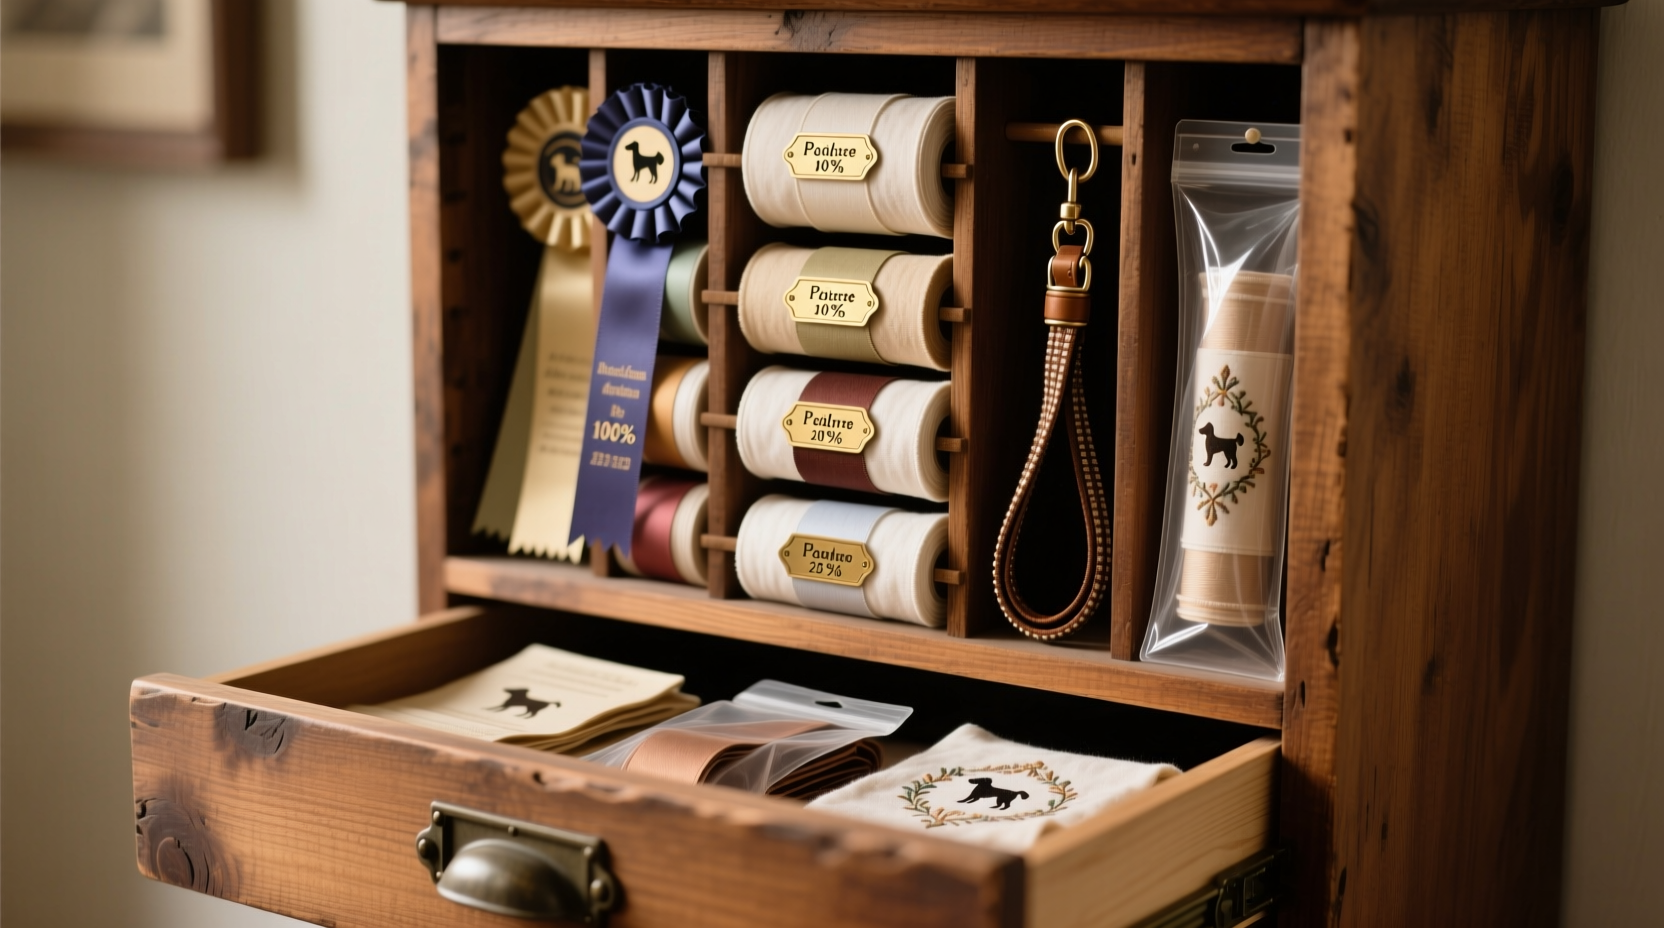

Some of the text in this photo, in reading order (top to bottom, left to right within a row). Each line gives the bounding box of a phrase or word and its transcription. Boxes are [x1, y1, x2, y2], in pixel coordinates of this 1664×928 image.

[815, 159, 844, 173] 10%
[814, 304, 845, 318] 10%
[592, 420, 636, 445] 100%
